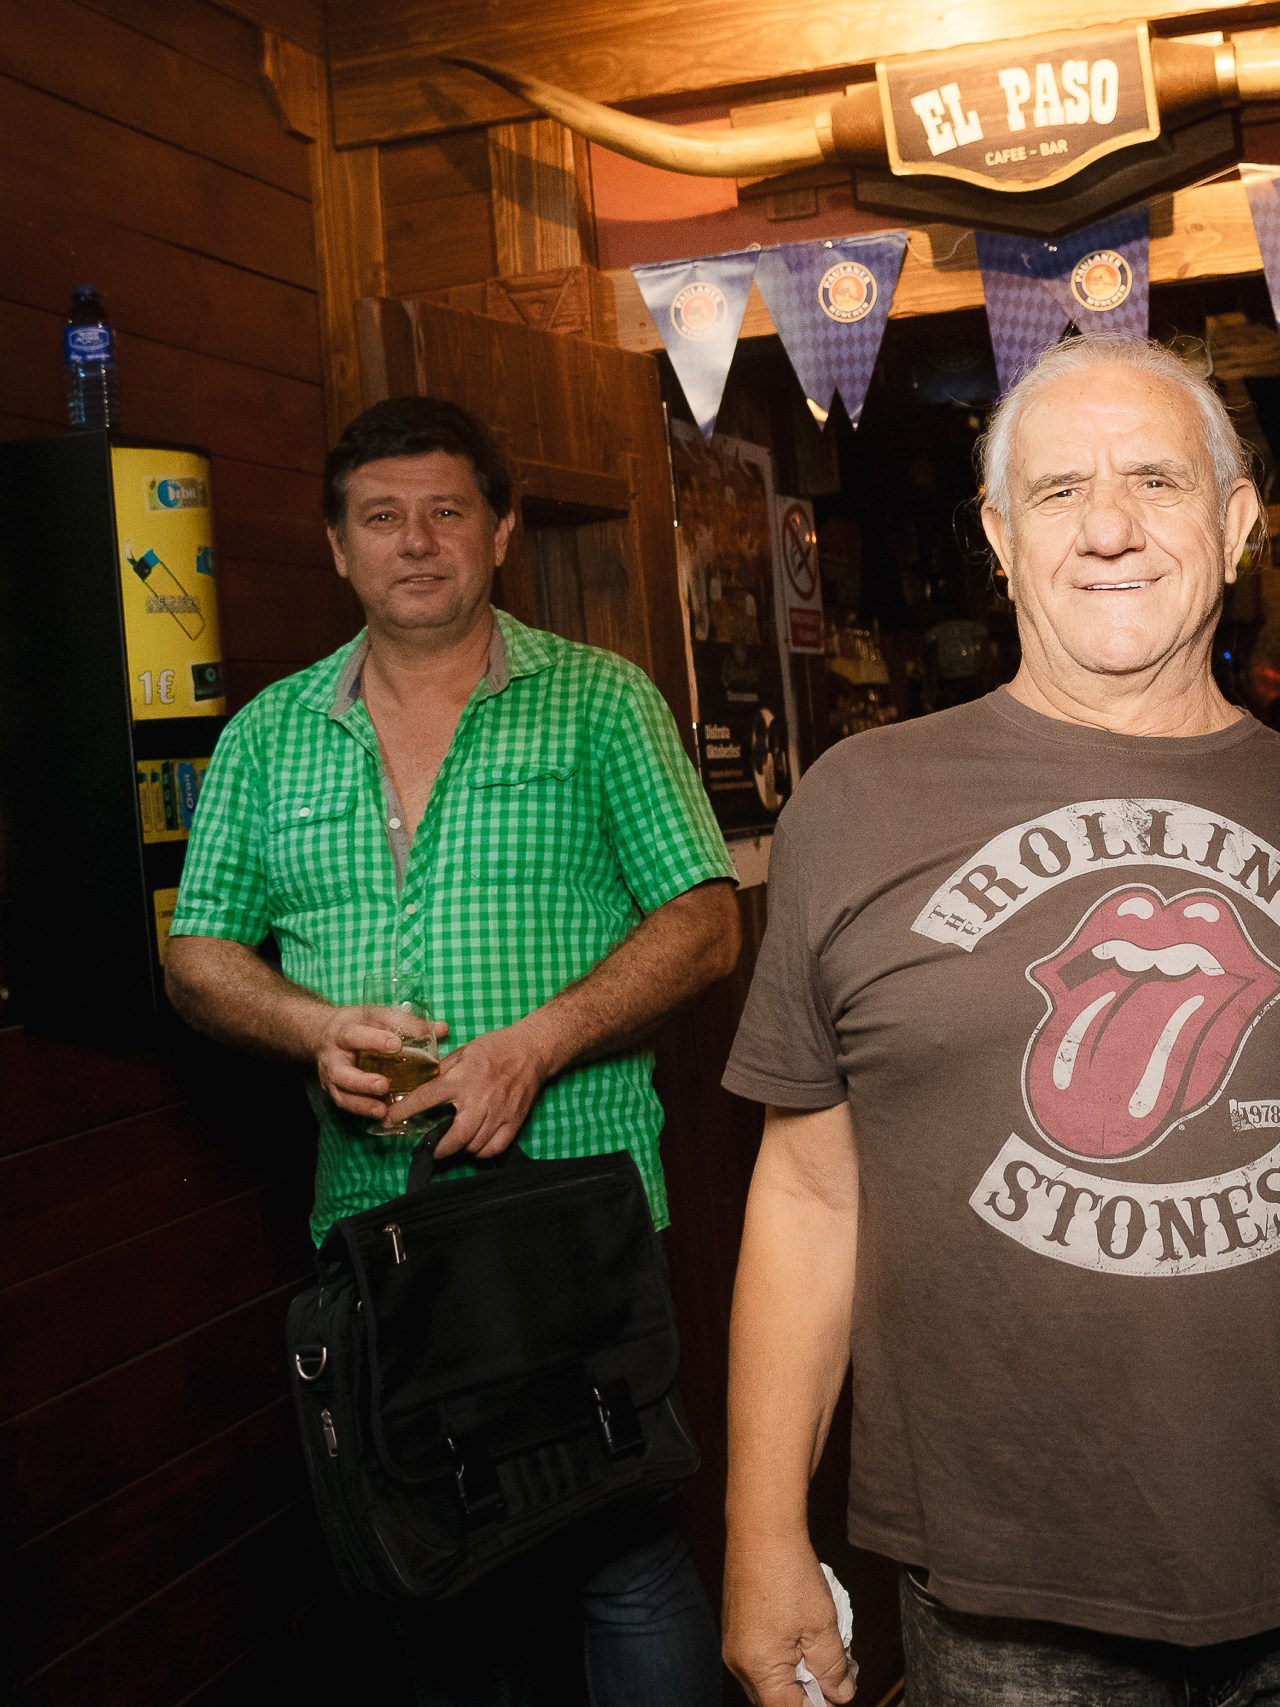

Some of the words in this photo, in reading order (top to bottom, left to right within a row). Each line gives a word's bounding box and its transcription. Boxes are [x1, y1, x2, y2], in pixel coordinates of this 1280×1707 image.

[910, 81, 985, 157] EL
[997, 58, 1119, 132] PASO
[984, 145, 1028, 167] CAFEE
[1039, 138, 1069, 157] BAR
[822, 265, 872, 289] PAULANER
[1075, 252, 1122, 284] PAULANER
[675, 285, 722, 310] PAULANER
[138, 668, 175, 706] 1€
[928, 904, 984, 936] THE
[1240, 1104, 1280, 1125] 1978
